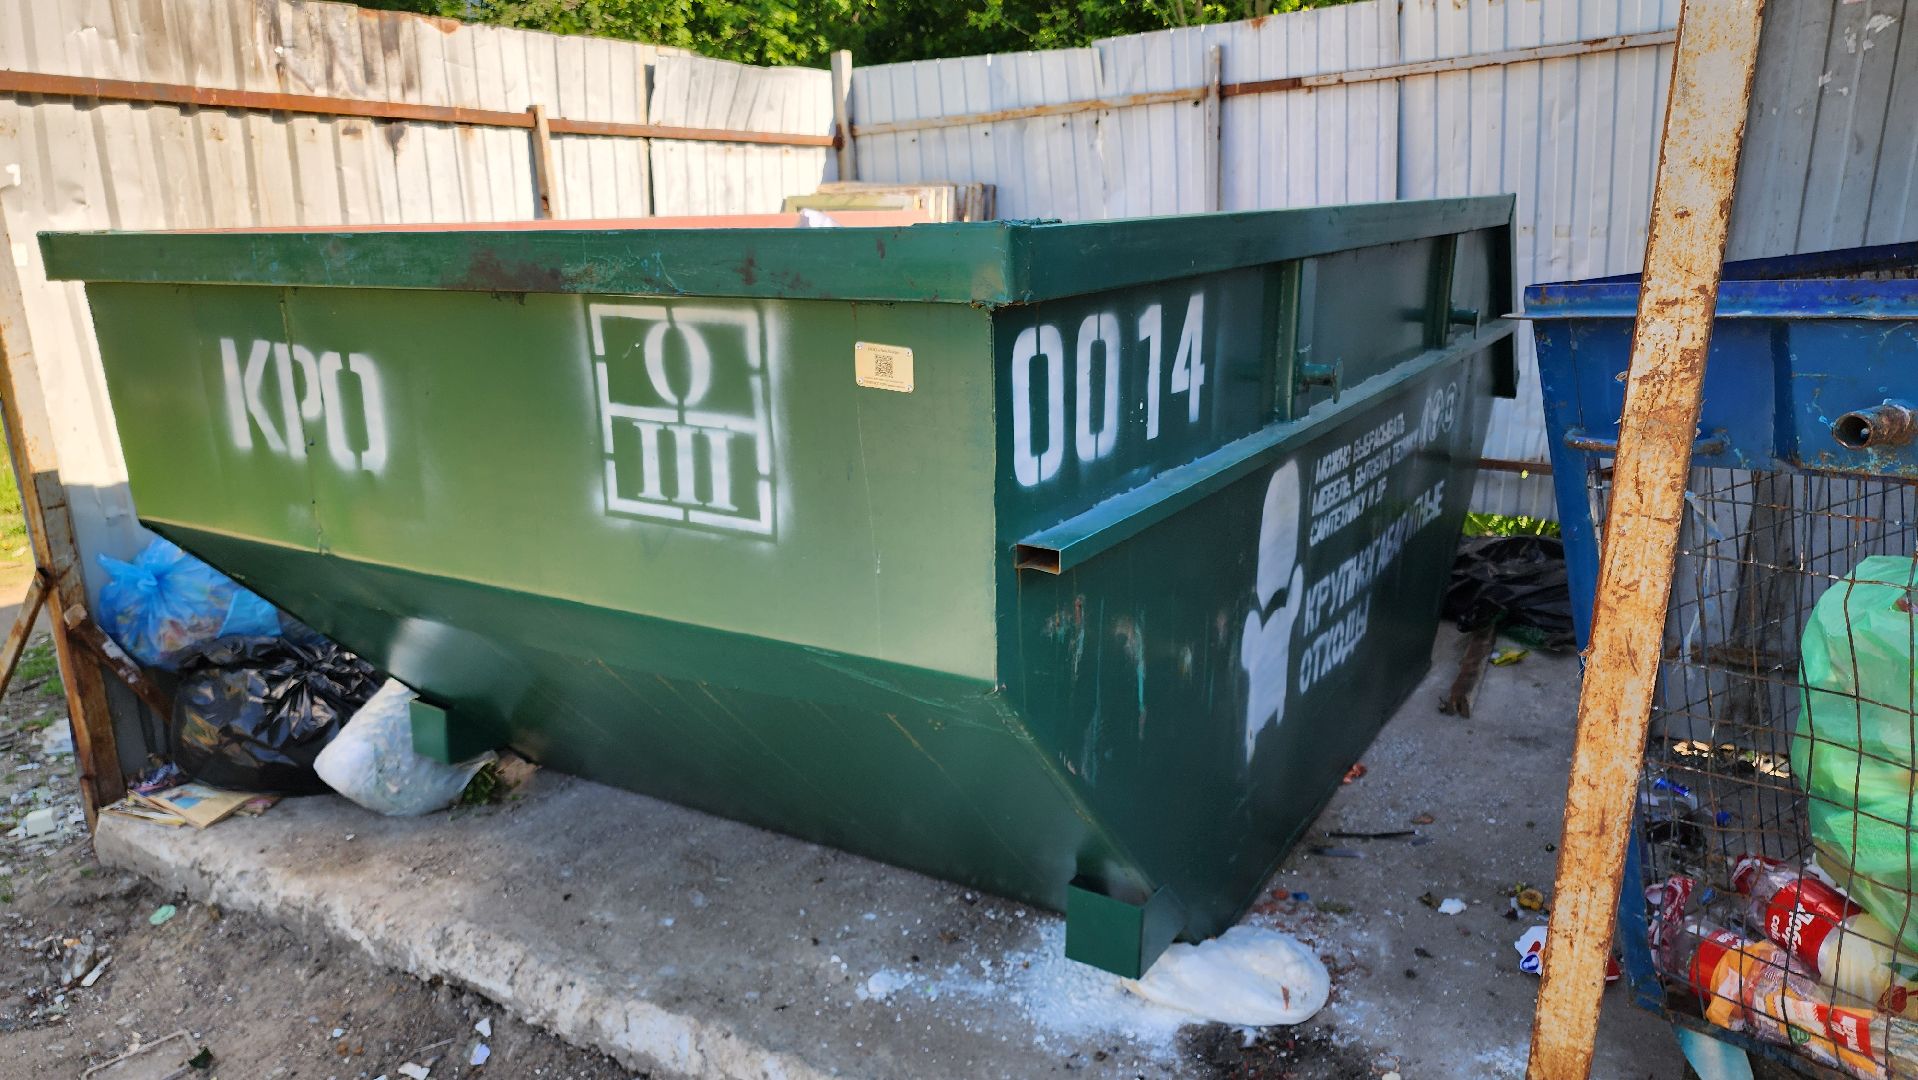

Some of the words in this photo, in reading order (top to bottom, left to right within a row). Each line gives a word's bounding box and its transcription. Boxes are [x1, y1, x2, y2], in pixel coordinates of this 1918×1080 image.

[219, 337, 387, 475] КРО
[1011, 292, 1206, 488] 0014
[1315, 444, 1351, 485] МОЖНО
[1354, 447, 1391, 493] БЫТОВУЮ
[1310, 490, 1368, 547] САНТЕХНИКУ
[1300, 592, 1373, 695] ОТХОДЫ
